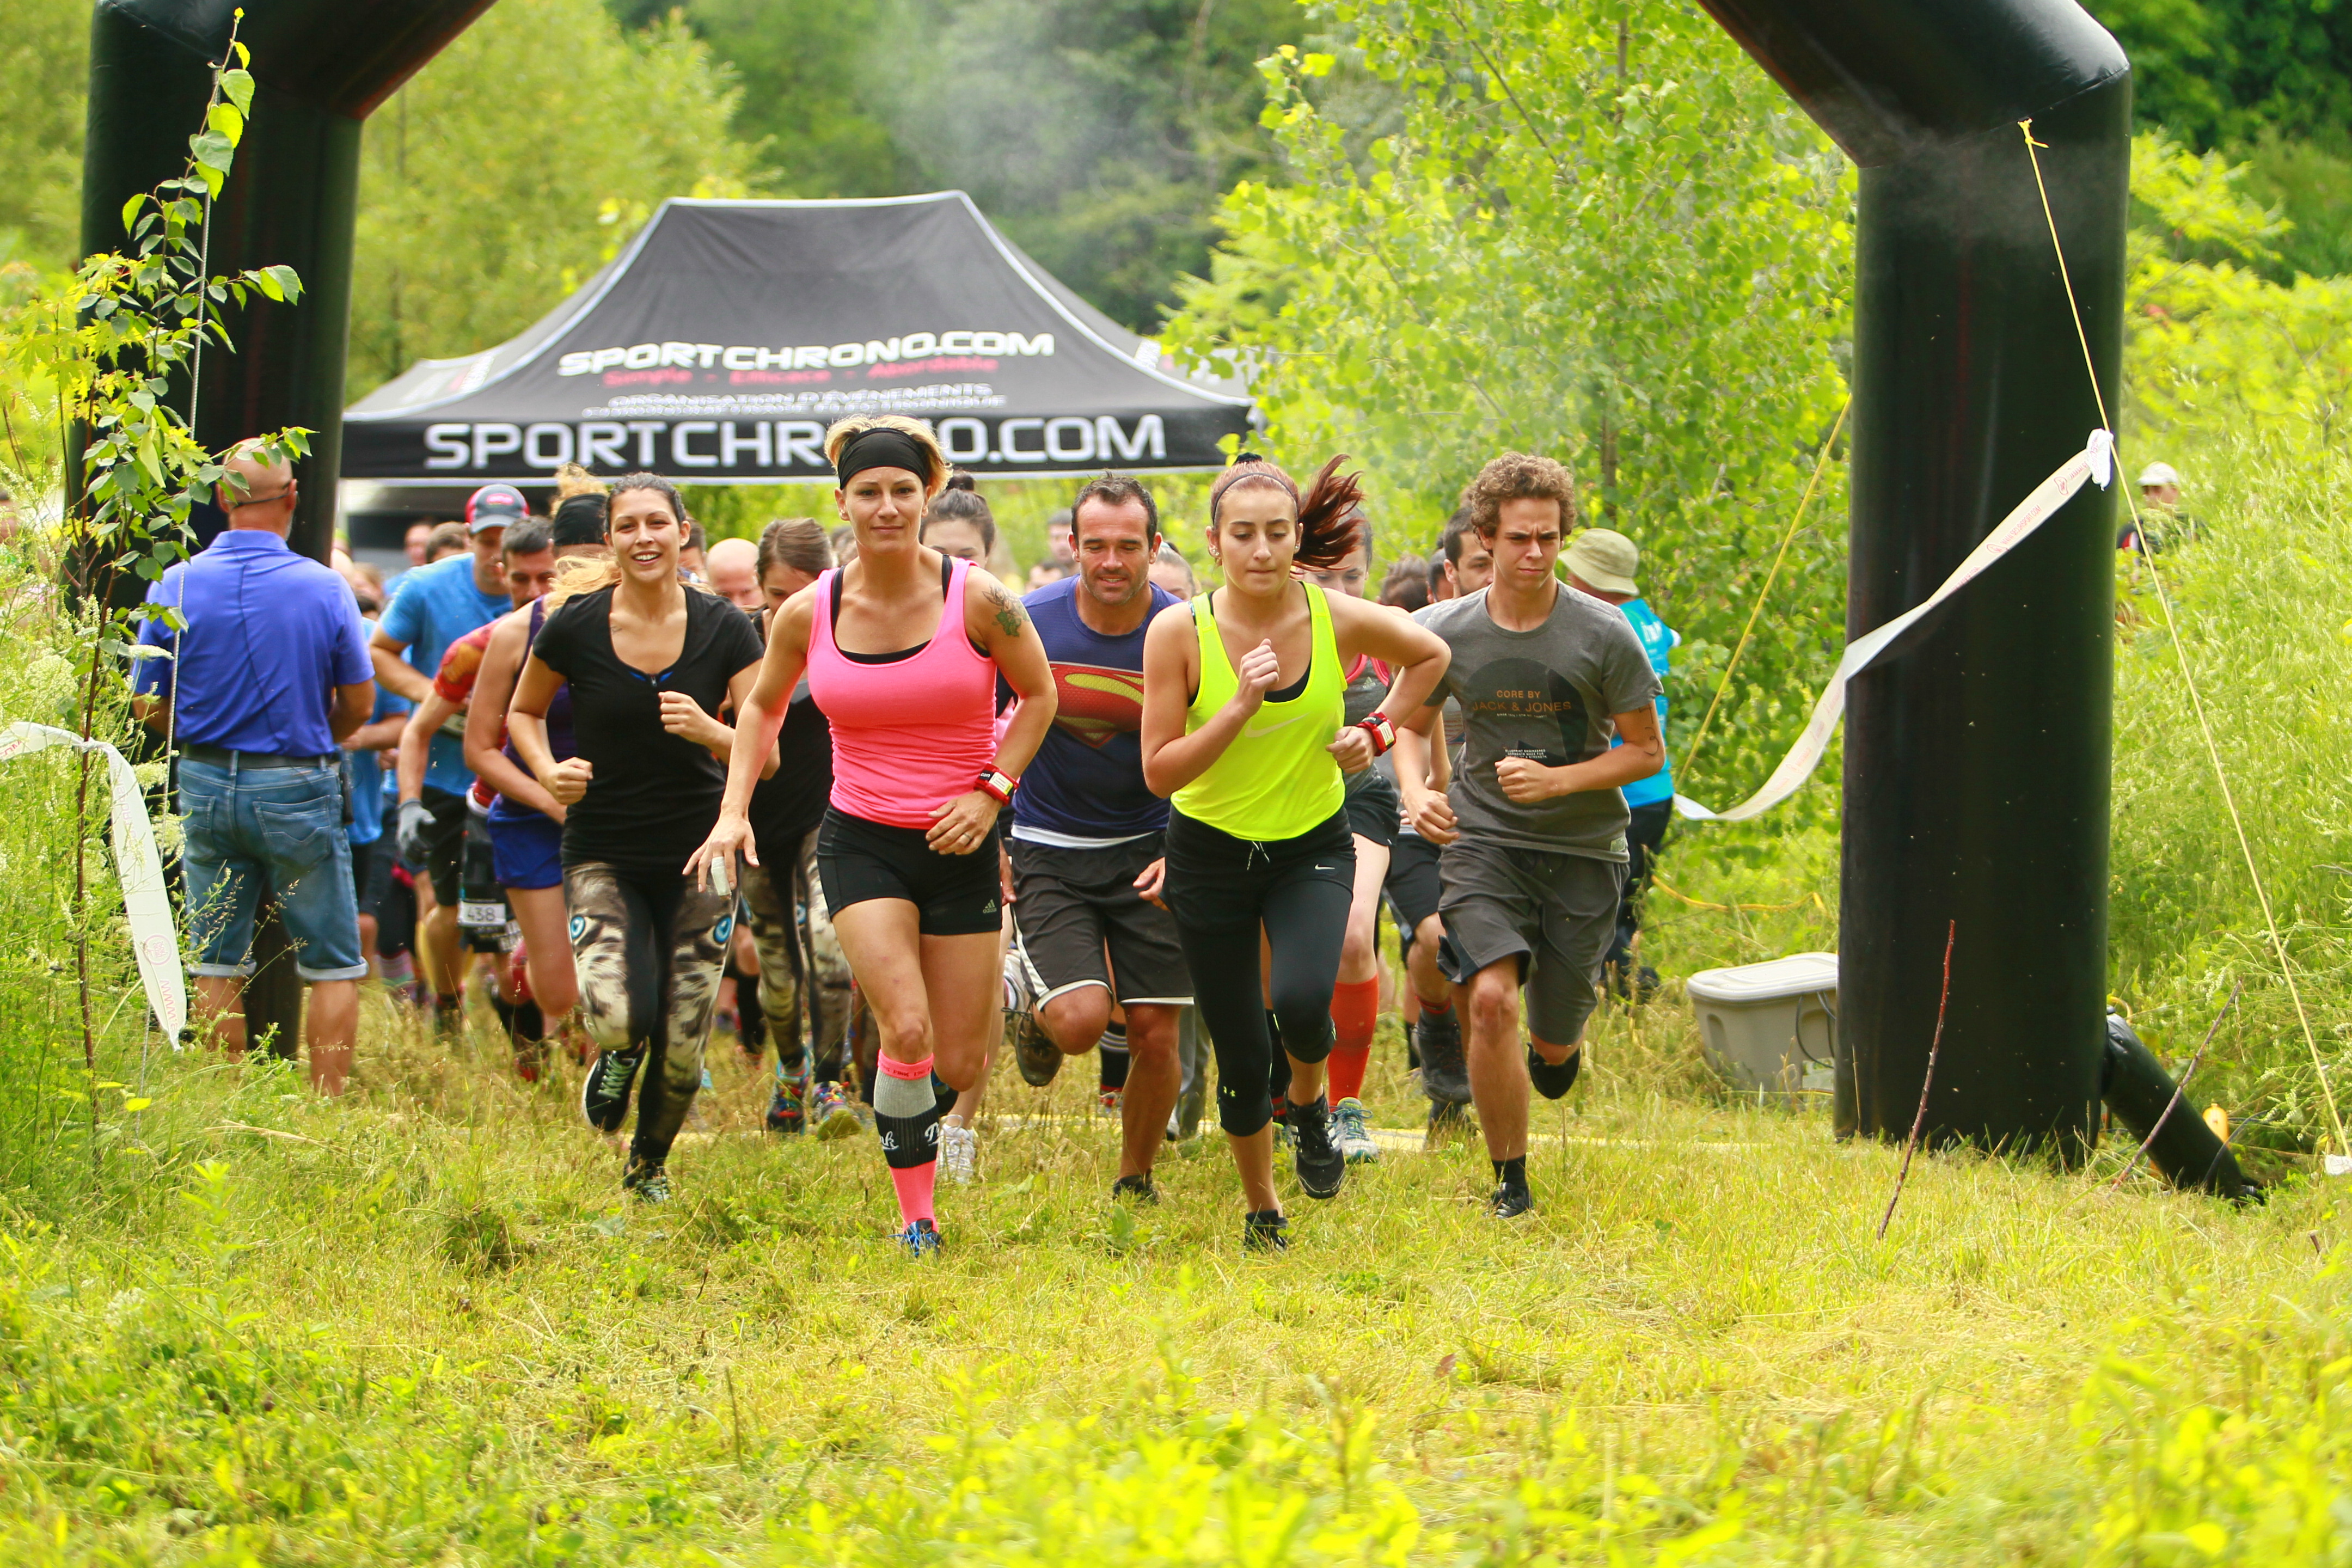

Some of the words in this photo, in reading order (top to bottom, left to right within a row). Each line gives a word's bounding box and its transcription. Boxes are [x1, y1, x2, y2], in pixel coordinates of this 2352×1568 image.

[556, 330, 1055, 377] SPORTCHRONO.COM
[424, 414, 1167, 469] SPORTCHRO.COM
[1472, 701, 1506, 711] JACK
[1512, 702, 1520, 712] &
[1526, 701, 1571, 713] JONES
[1497, 690, 1524, 698] CORE
[1528, 690, 1541, 699] BY
